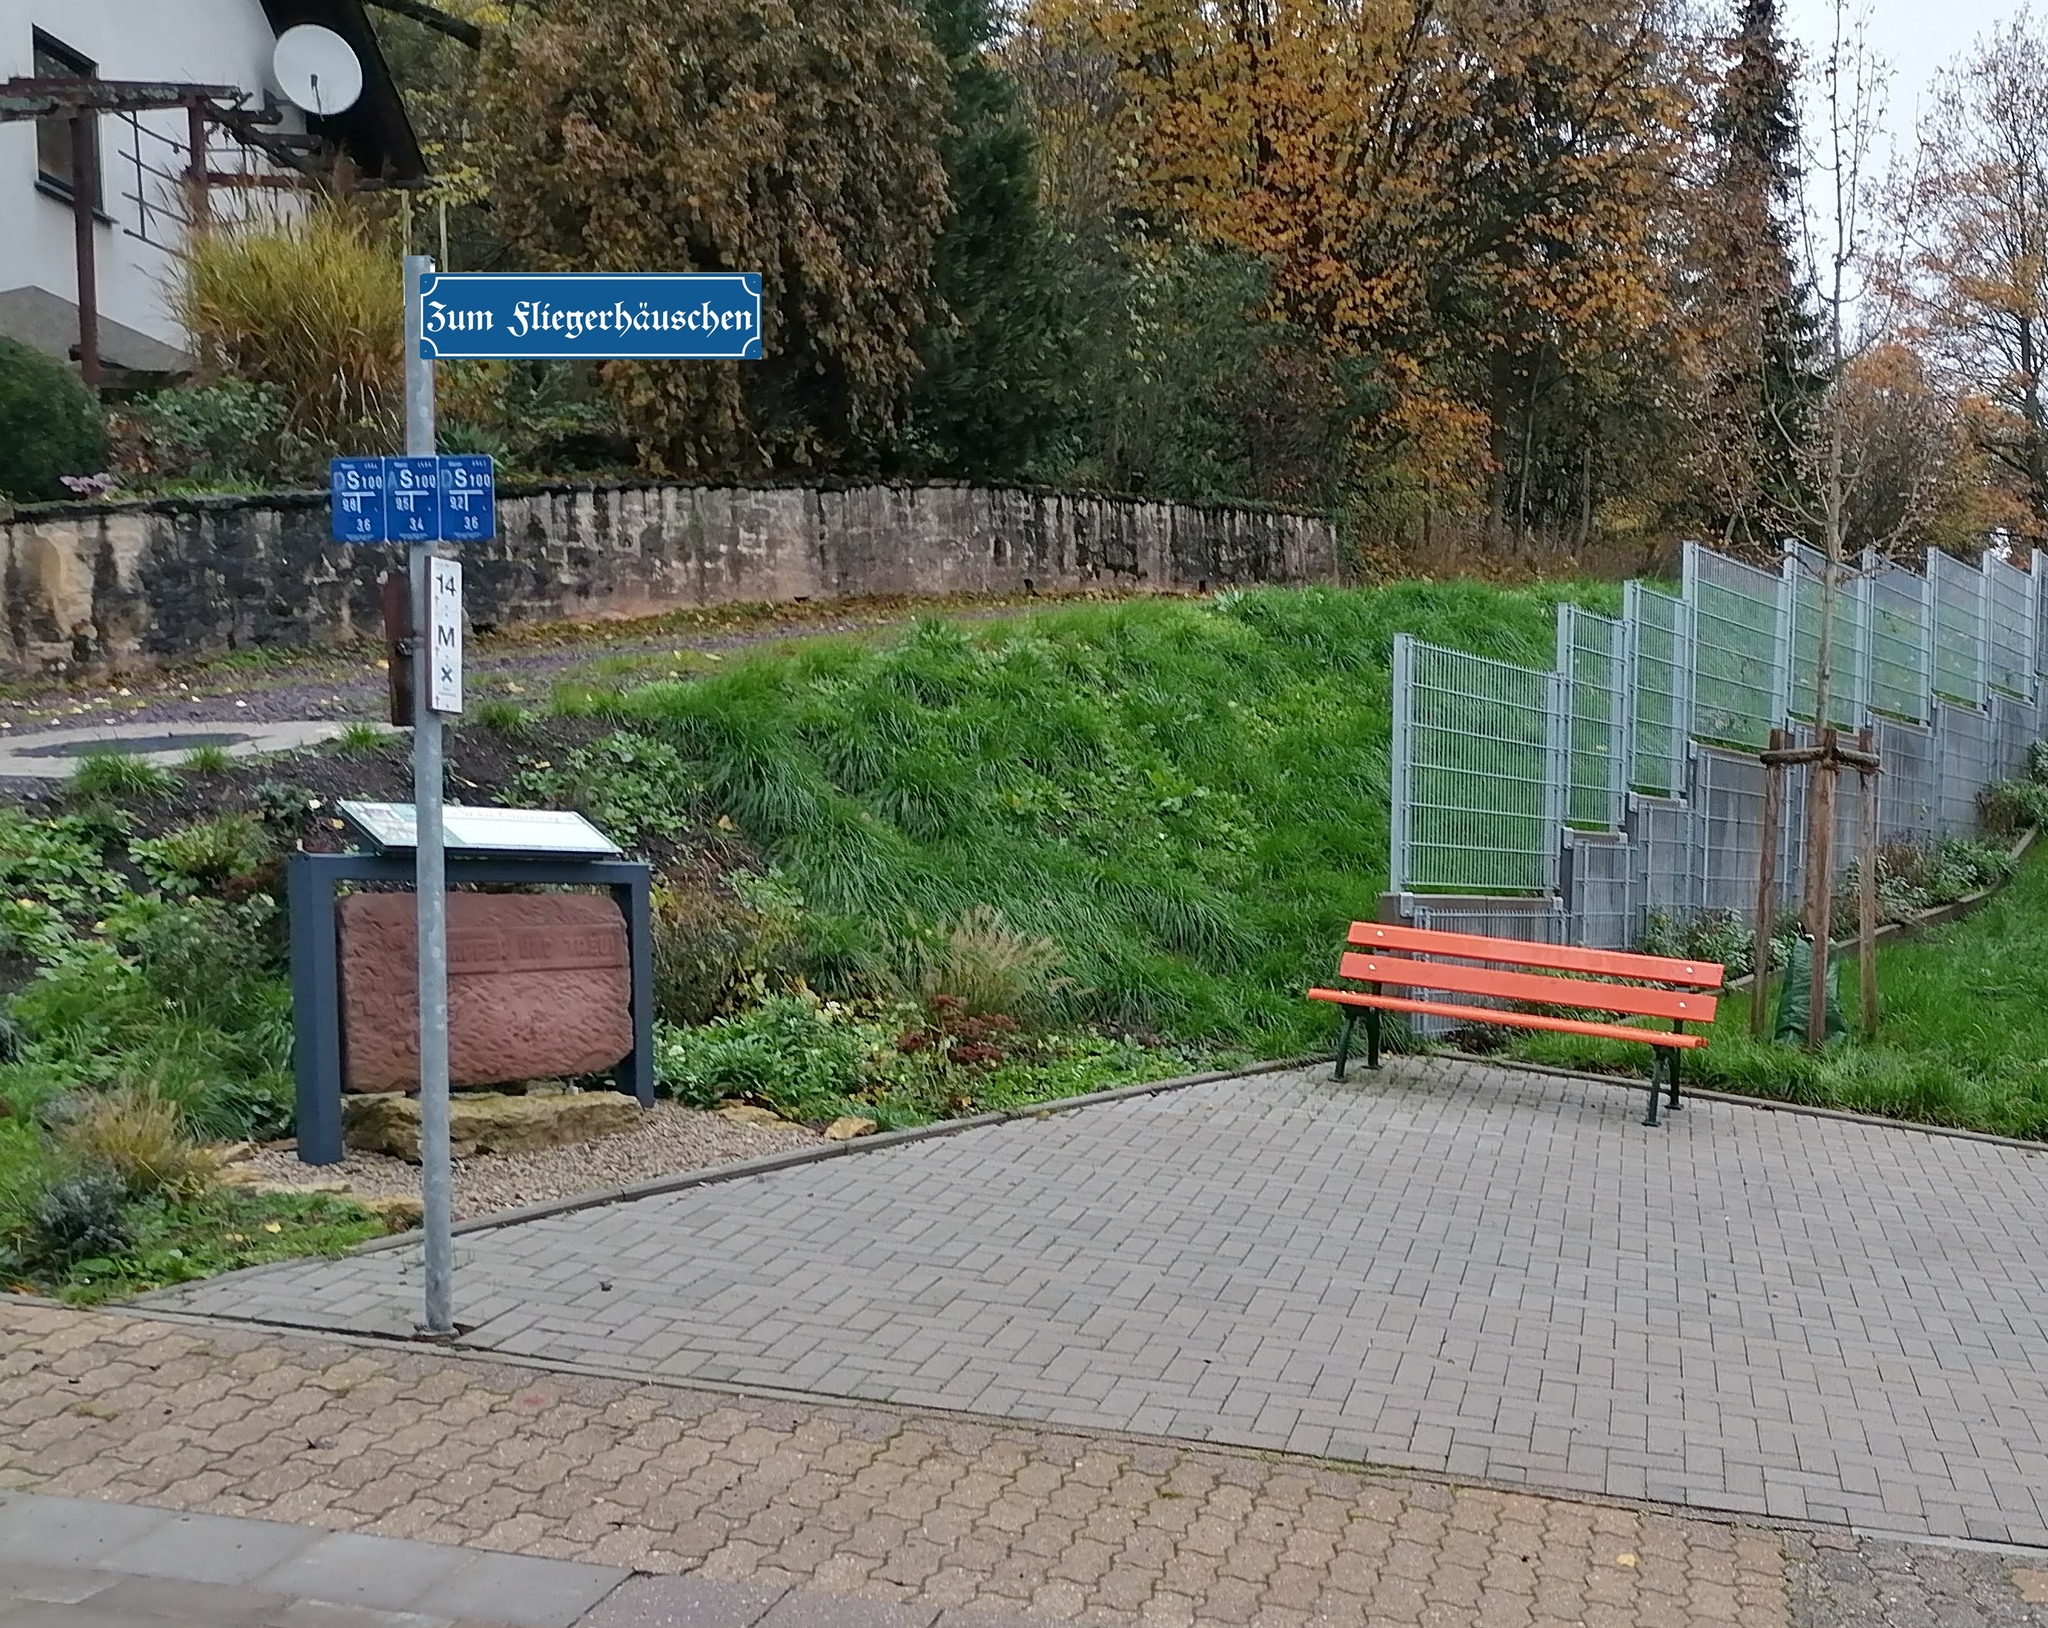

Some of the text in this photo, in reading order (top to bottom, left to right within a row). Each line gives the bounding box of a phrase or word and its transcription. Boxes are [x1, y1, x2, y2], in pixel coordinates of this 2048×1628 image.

[426, 300, 754, 339] Zum Fliegerhäuschen
[436, 573, 457, 597] 14
[438, 624, 455, 648] M
